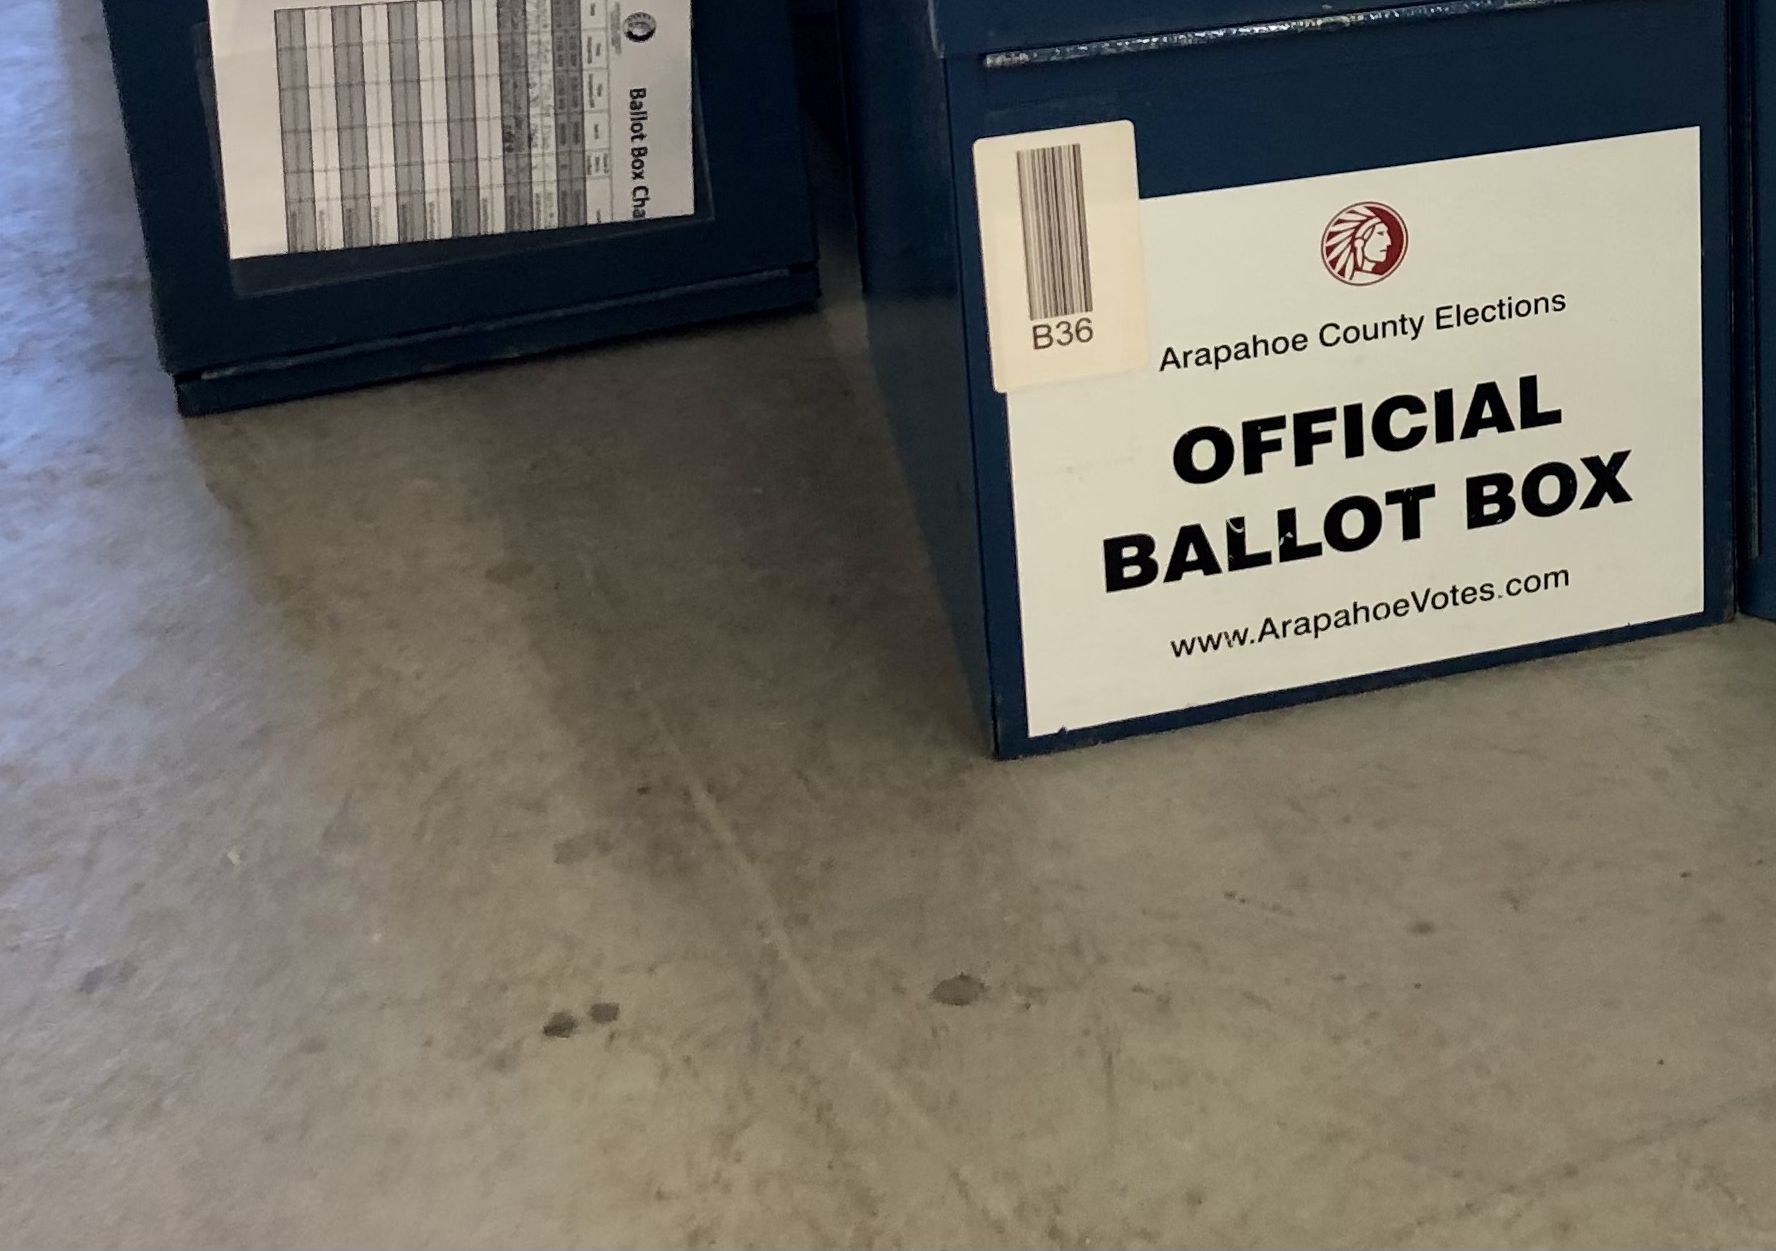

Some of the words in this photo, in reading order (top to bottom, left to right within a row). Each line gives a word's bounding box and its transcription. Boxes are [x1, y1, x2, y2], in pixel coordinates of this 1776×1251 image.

[629, 87, 648, 144] Ballot
[630, 146, 649, 181] Box
[1031, 316, 1094, 351] B36
[1159, 330, 1309, 372] Arapahoe
[1318, 314, 1425, 352] County
[1434, 291, 1568, 330] Elections
[1171, 374, 1563, 486] OFFICIAL
[1102, 483, 1437, 594] BALLOT
[1464, 449, 1633, 530] BOX
[1170, 566, 1571, 659] www.ArapahoeVotes.com
